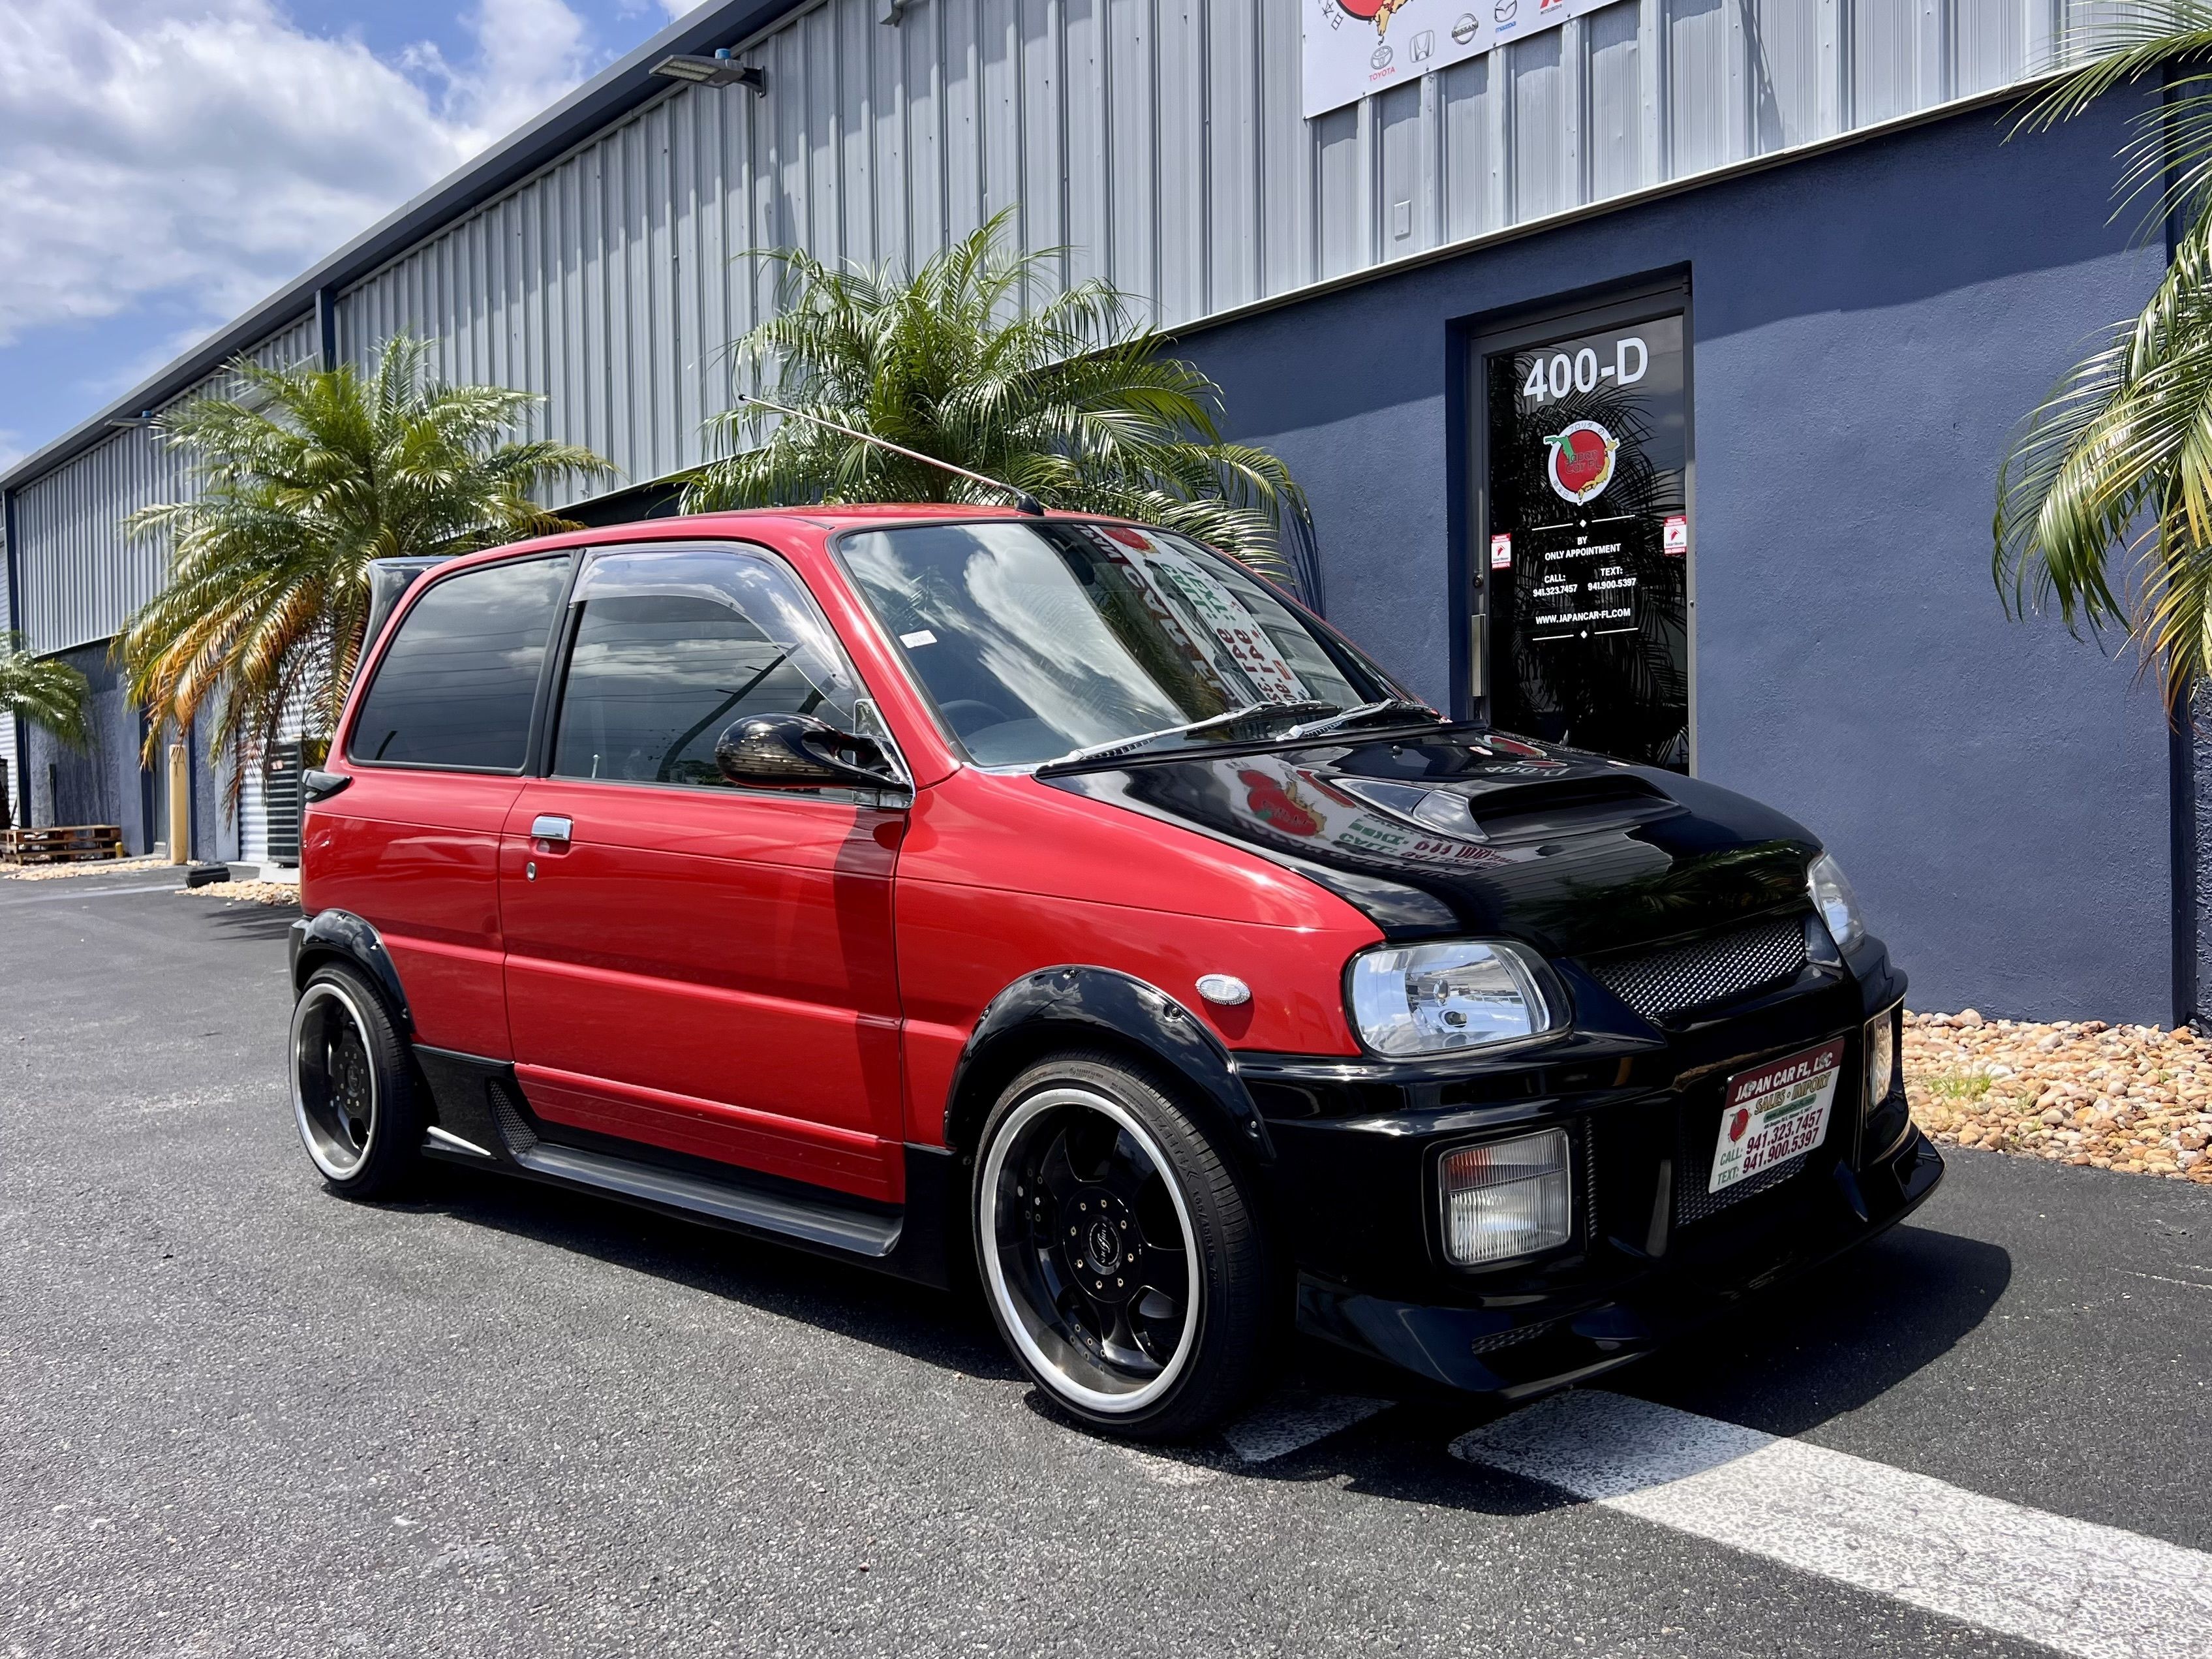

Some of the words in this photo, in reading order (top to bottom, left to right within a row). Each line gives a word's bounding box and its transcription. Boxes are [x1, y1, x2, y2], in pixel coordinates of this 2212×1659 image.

[1368, 67, 1395, 81] TOYOTA
[1523, 337, 1648, 403] 400-D
[1577, 536, 1588, 546] BY
[1544, 550, 1565, 561] ONLY
[1565, 543, 1621, 558] APPOINTMENT
[1544, 574, 1566, 583] CALL:
[1601, 566, 1623, 576] TEXT:
[1533, 583, 1578, 597] 941.323.7457
[1588, 578, 1636, 591] 941.900.5397
[1535, 608, 1631, 625] WWW.JAPANCAR-FL.COM
[1734, 1074, 1772, 1102] JAPAN
[1773, 1066, 1796, 1087] CAR
[1796, 1061, 1811, 1079] FL,
[1754, 1089, 1786, 1115] SALES
[1791, 1071, 1832, 1101] IMPORT
[1720, 1147, 1743, 1166] CALL:
[1746, 1108, 1823, 1155] 941.323.7457
[1717, 1166, 1740, 1185] TEXT:
[1742, 1126, 1819, 1174] 941.900.5397
